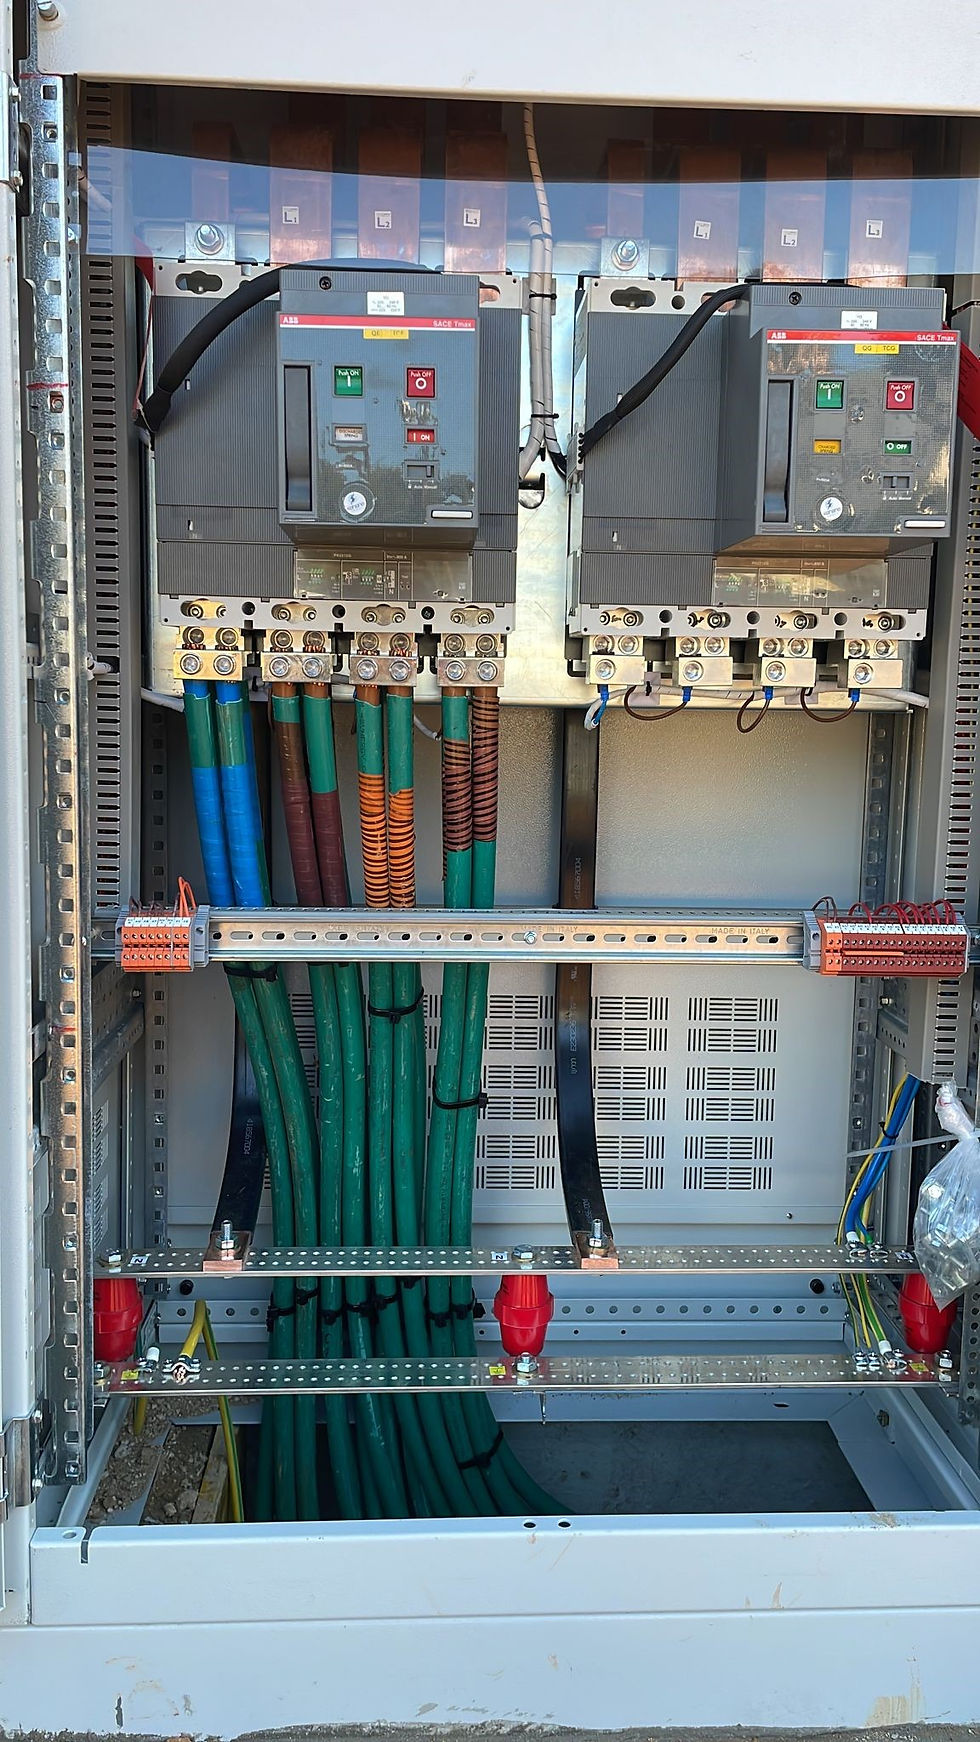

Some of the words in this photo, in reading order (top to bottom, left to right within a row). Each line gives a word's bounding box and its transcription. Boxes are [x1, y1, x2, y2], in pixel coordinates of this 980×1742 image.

[284, 211, 297, 223] L1
[377, 216, 390, 228] L2
[465, 213, 478, 225] L3
[695, 226, 708, 239] L1
[868, 224, 880, 236] L3
[783, 234, 796, 246] L2
[283, 316, 299, 325] ABB
[432, 319, 452, 327] SACE
[454, 320, 472, 328] Tmax
[771, 332, 787, 340] ABB
